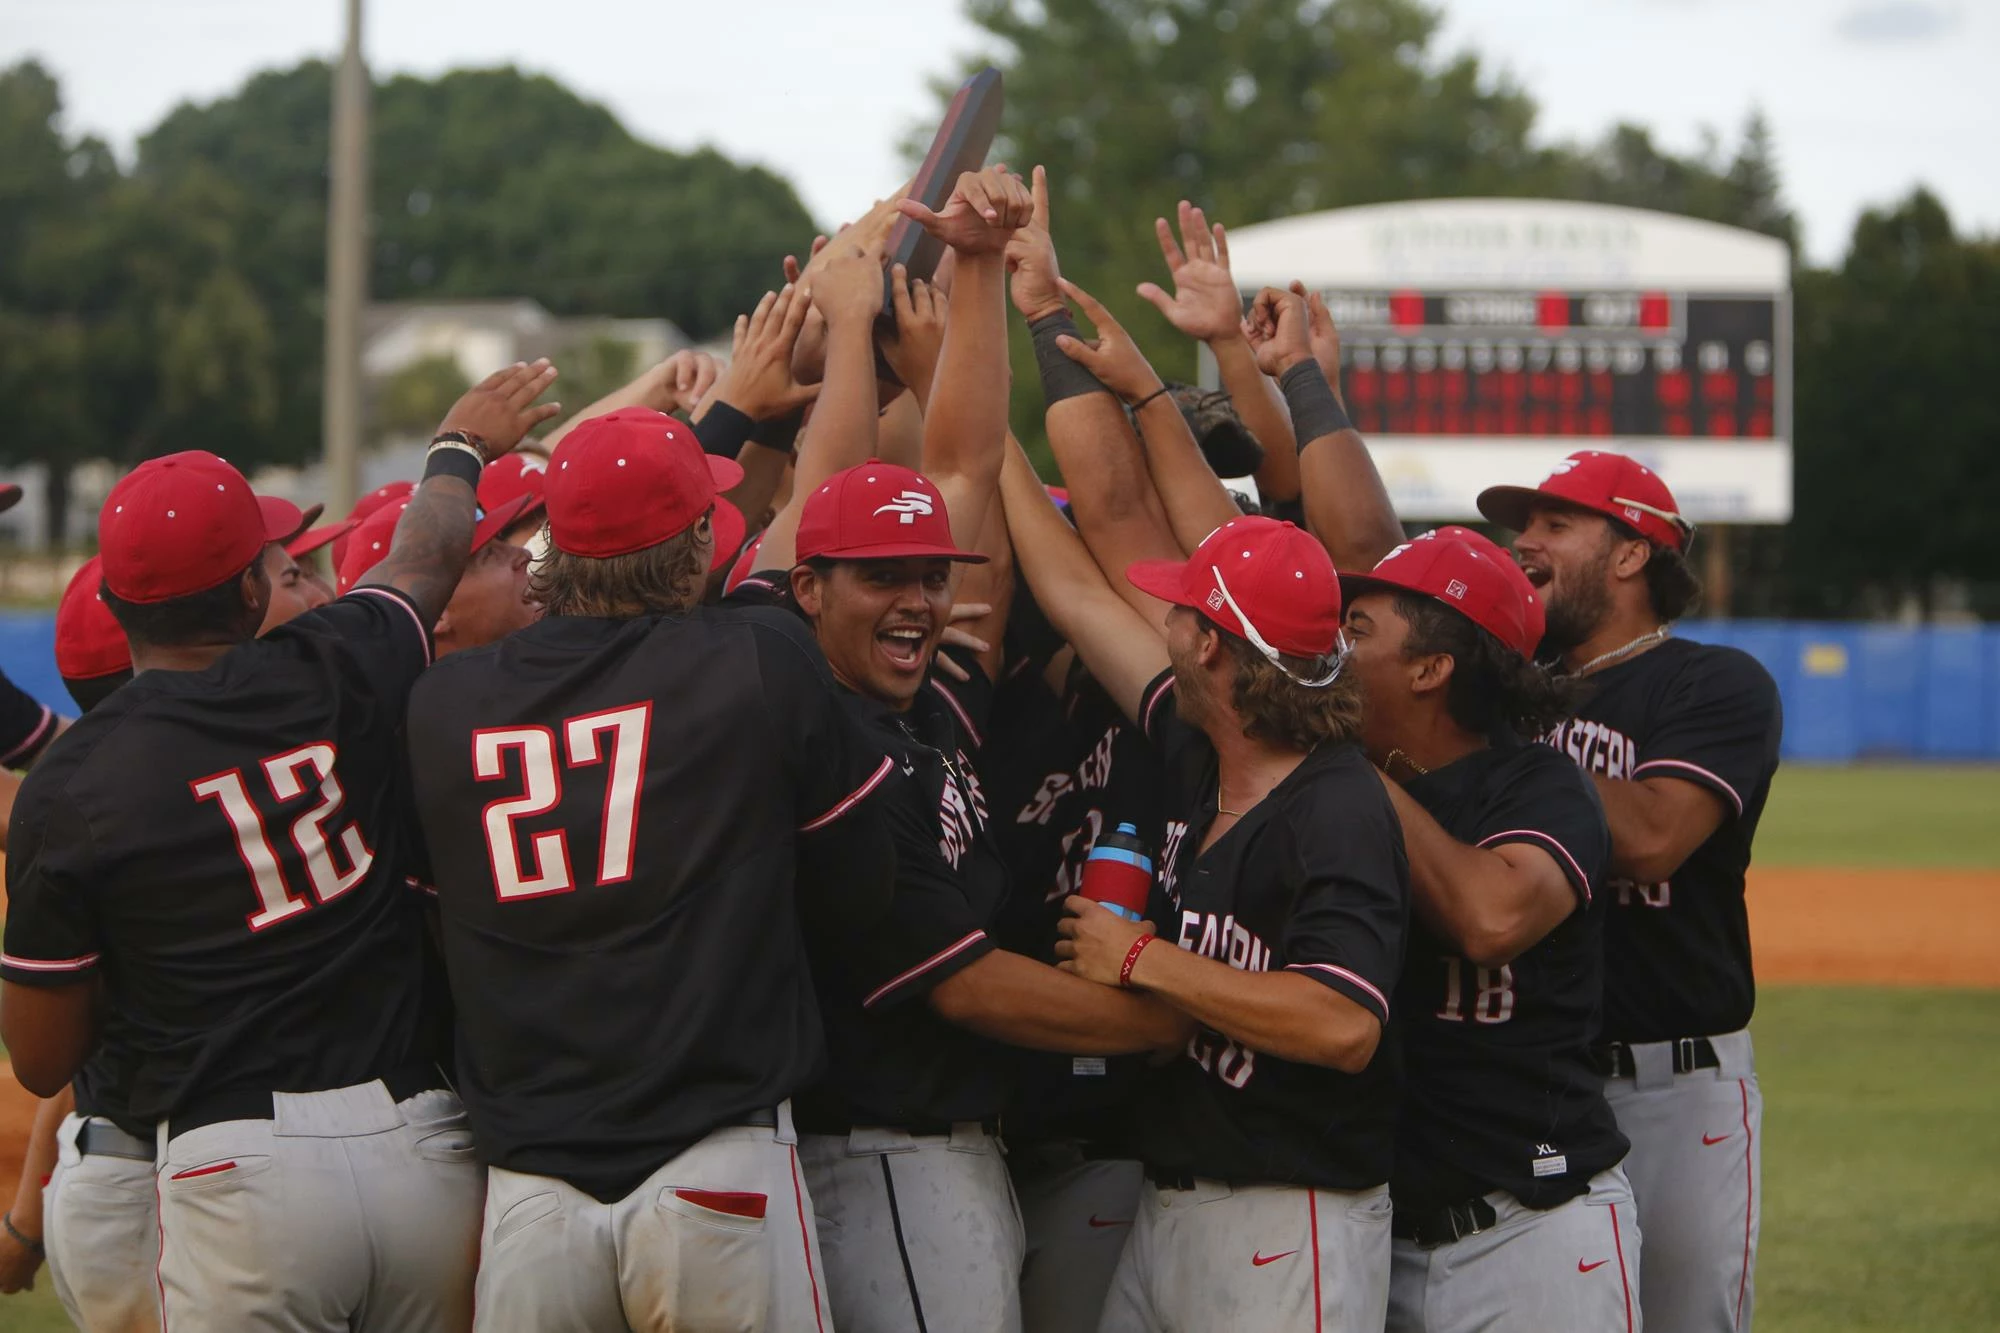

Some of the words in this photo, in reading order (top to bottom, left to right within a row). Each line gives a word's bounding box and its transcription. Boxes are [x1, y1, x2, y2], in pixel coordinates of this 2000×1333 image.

[189, 740, 374, 932] 12
[472, 700, 653, 902] 27
[1435, 956, 1515, 1025] 18
[1535, 1143, 1557, 1155] XL
